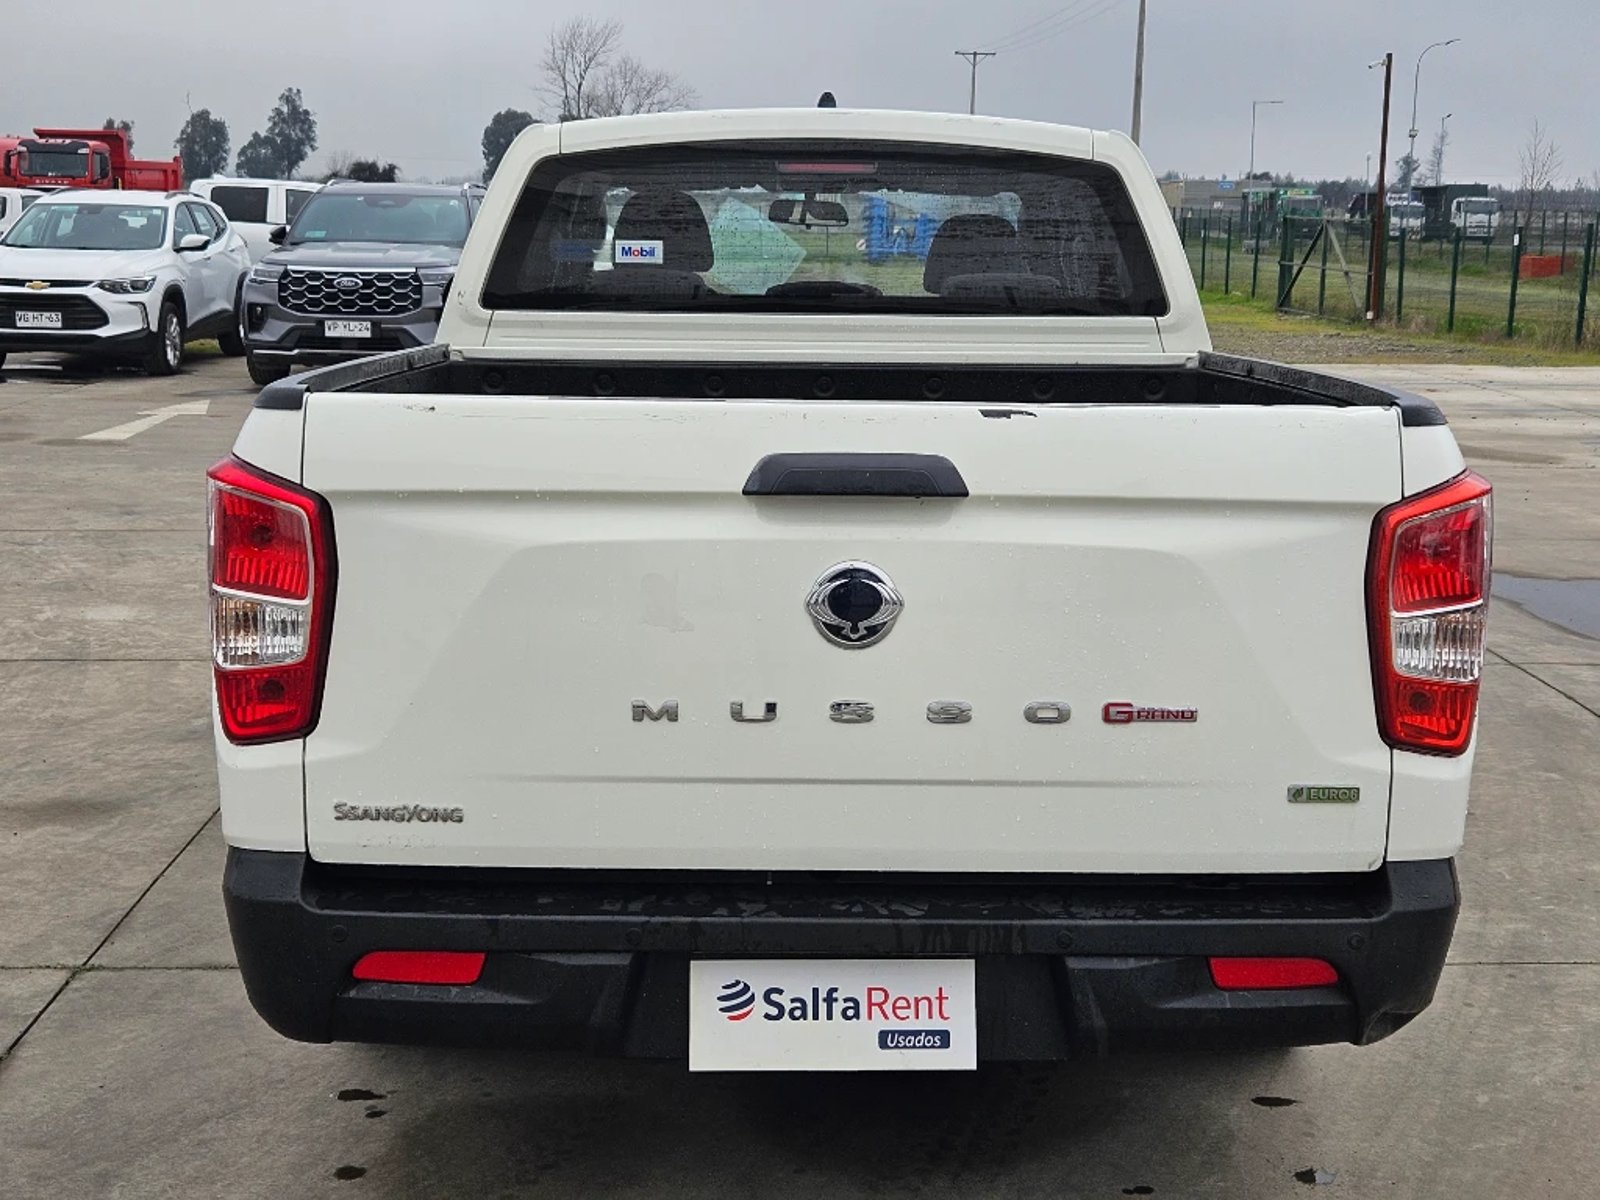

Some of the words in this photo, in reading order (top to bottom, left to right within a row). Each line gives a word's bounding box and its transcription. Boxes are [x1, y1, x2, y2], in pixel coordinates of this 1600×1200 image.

[621, 246, 656, 257] Mobil
[631, 700, 1072, 724] MUSSO
[1310, 788, 1358, 800] EURO6
[762, 986, 950, 1021] SalfaRent
[886, 1032, 942, 1048] Usados
